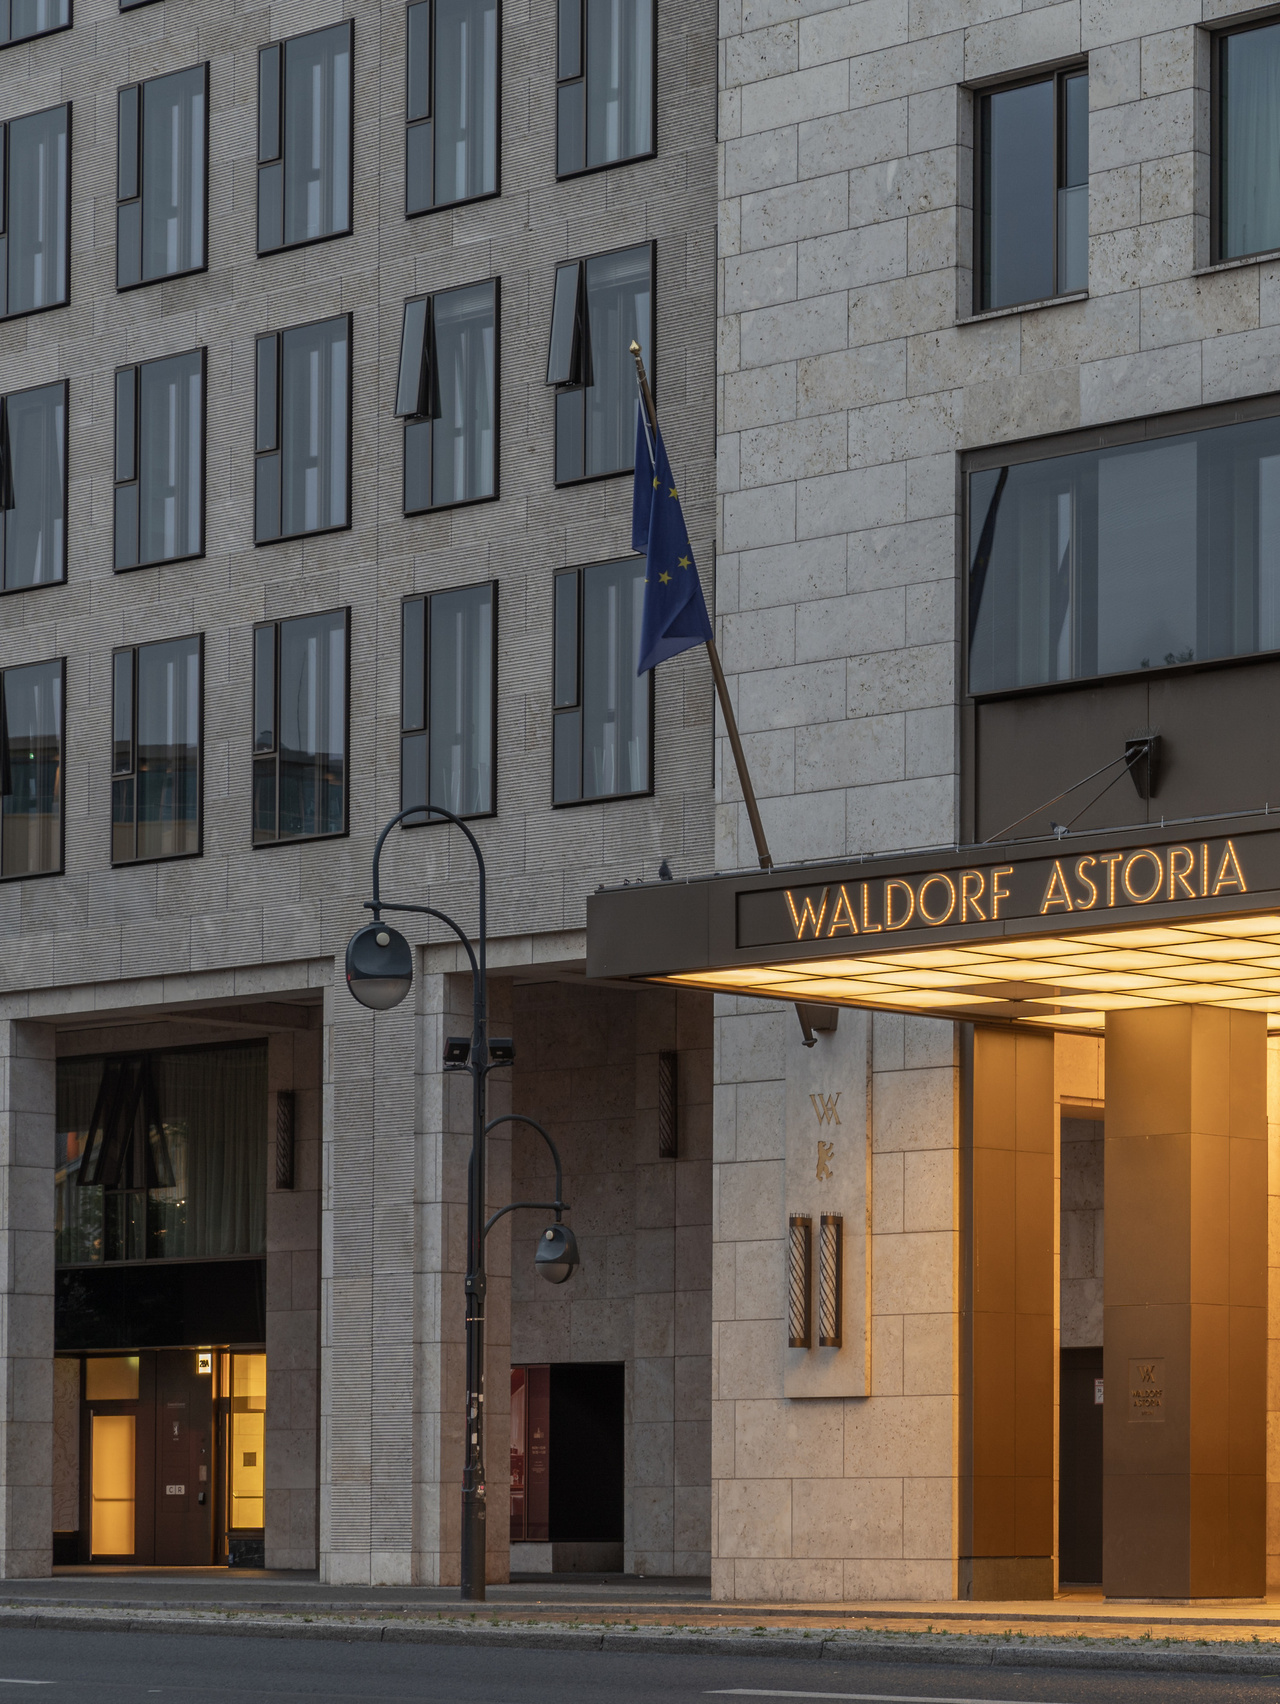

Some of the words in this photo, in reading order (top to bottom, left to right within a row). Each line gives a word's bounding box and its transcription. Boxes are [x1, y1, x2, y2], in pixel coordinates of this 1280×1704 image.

[784, 866, 1013, 939] WALDORF
[1040, 840, 1247, 914] ASTORIA
[1131, 1389, 1163, 1398] WALDORF
[1133, 1398, 1161, 1408] ASTORIA
